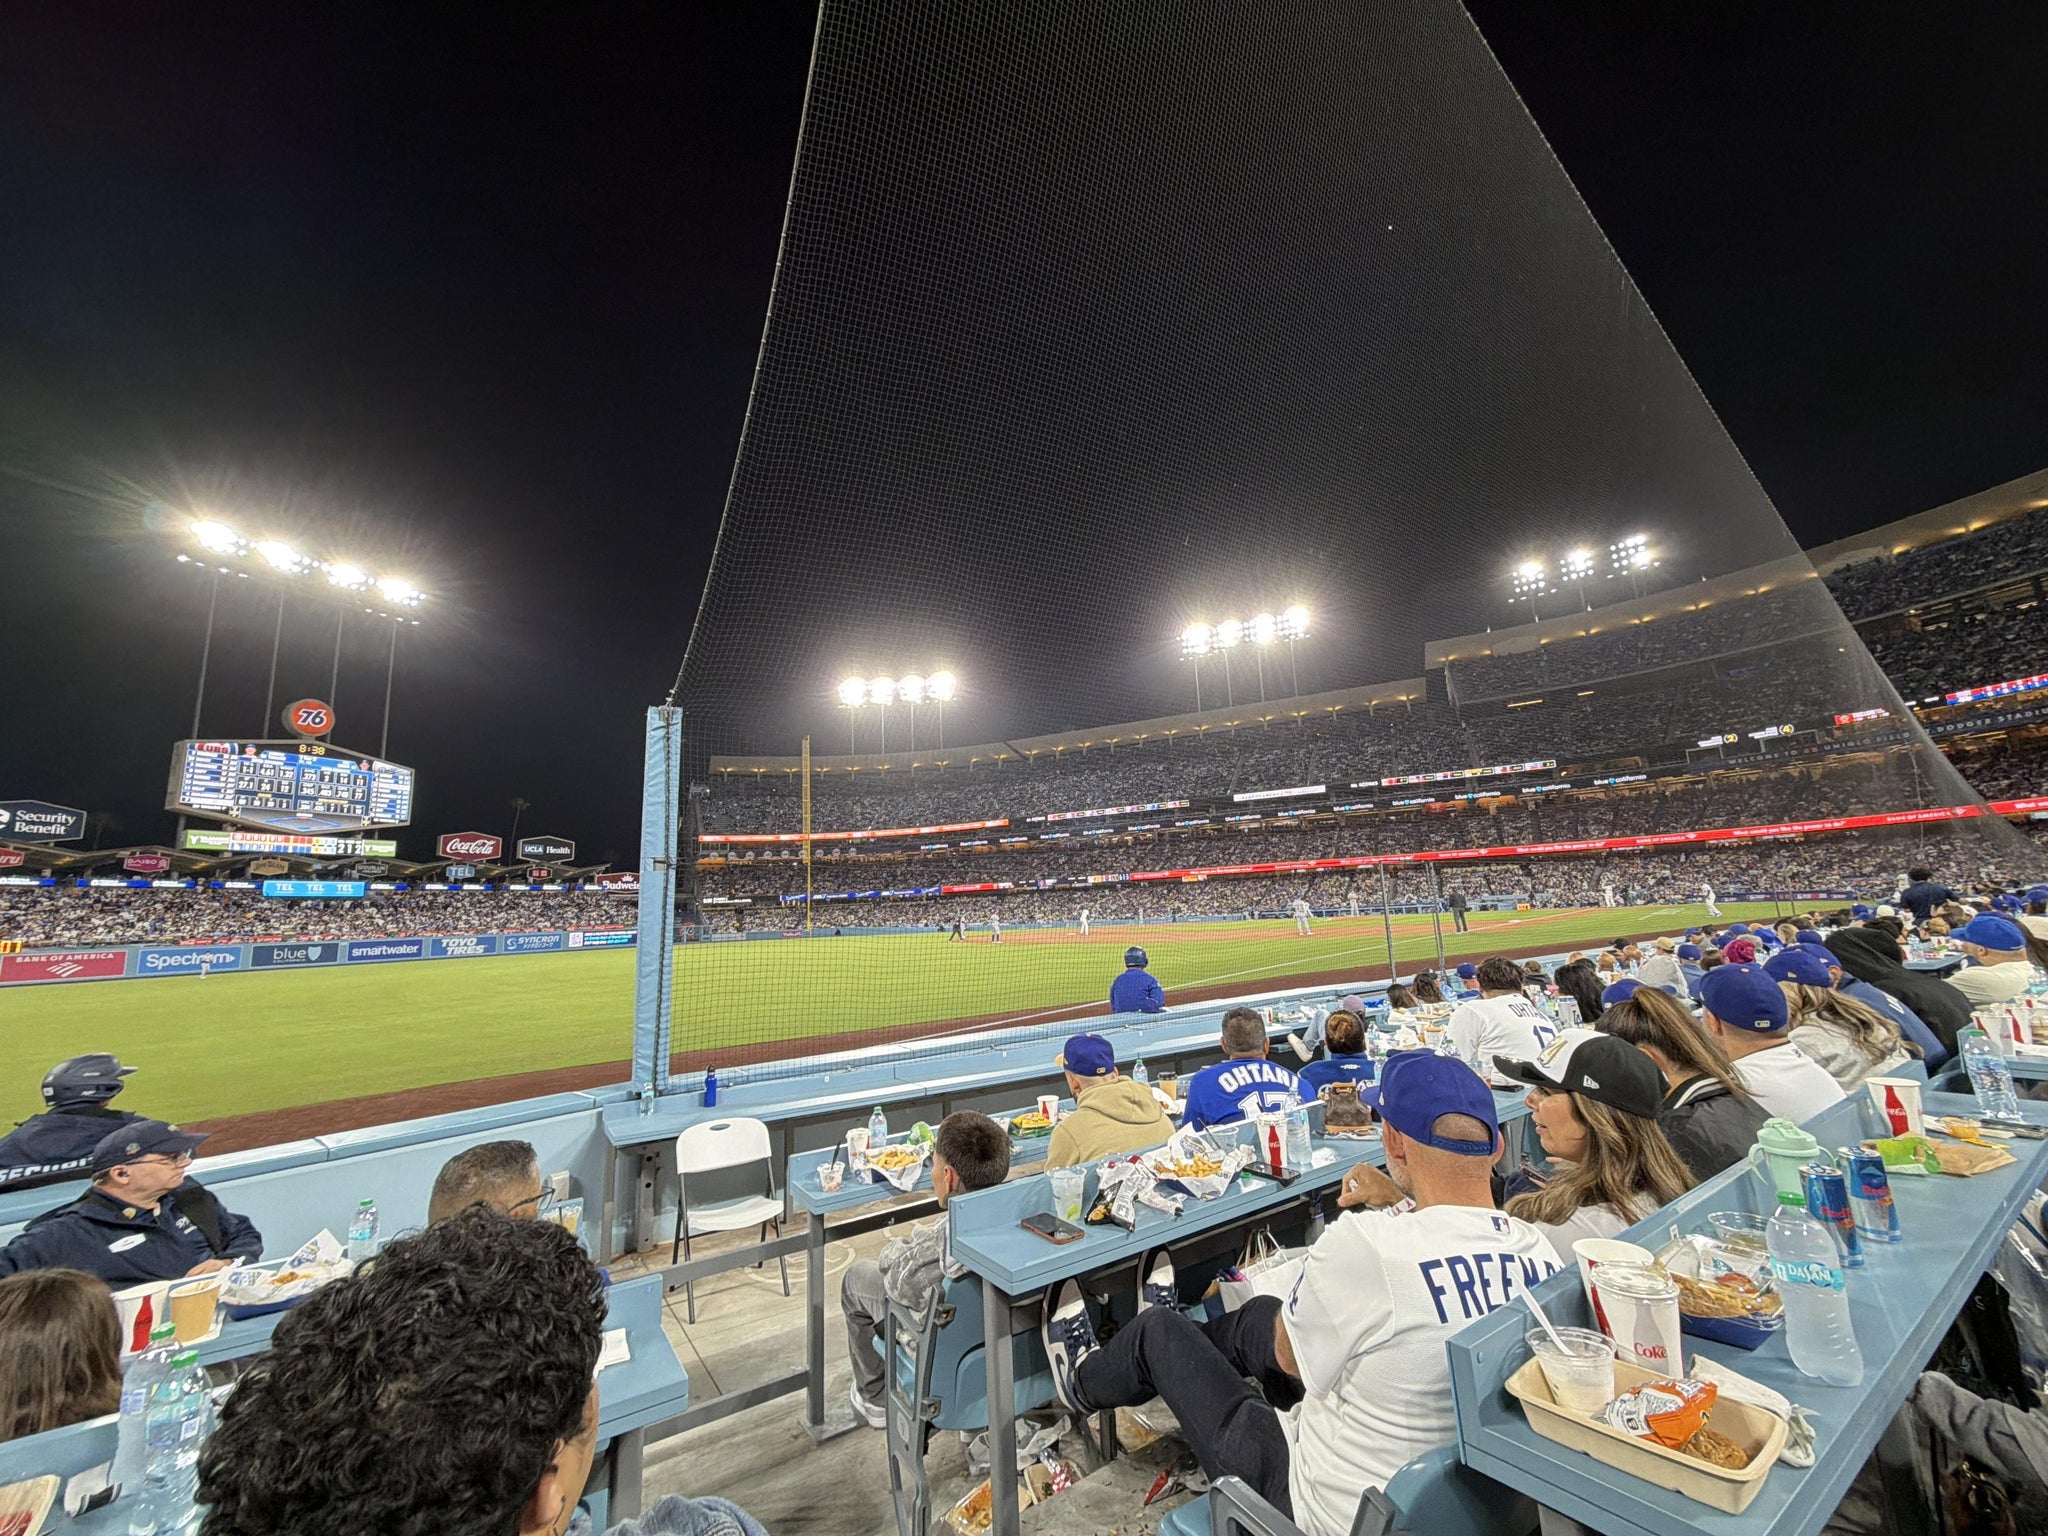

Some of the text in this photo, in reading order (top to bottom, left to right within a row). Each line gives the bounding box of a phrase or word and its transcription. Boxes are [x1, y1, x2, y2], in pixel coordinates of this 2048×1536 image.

[298, 709, 327, 727] 76
[1937, 718, 1991, 732] DODGER
[299, 744, 325, 755] 8:38
[1728, 752, 1779, 765] WELCOME
[239, 781, 253, 789] 27.1
[1615, 774, 1647, 783] california
[1542, 783, 1571, 791] california
[16, 810, 76, 826] Security
[1886, 815, 1906, 823] BANK
[1918, 811, 1950, 819] AMERICA
[14, 821, 66, 835] Benefit
[338, 844, 345, 853] 2
[355, 845, 361, 854] 2
[446, 838, 496, 855] Coca-Cola
[546, 847, 570, 855] Health
[450, 867, 474, 877] TEL
[275, 884, 354, 892] TEL TEL TEL
[441, 937, 477, 947] TOYO
[517, 935, 559, 944] SYNCRON
[273, 947, 306, 960] blue
[352, 944, 419, 957] smartwater
[446, 945, 485, 955] TIRES
[65, 953, 114, 961] AMERICA
[146, 952, 229, 970] Spectrm
[1533, 1025, 1556, 1049] 17
[1218, 1063, 1299, 1093] OHTANI
[1238, 1091, 1290, 1120] 17
[1788, 1263, 1832, 1281] DASANI
[1418, 1253, 1566, 1324] FREEM
[1634, 1342, 1668, 1359] Coke
